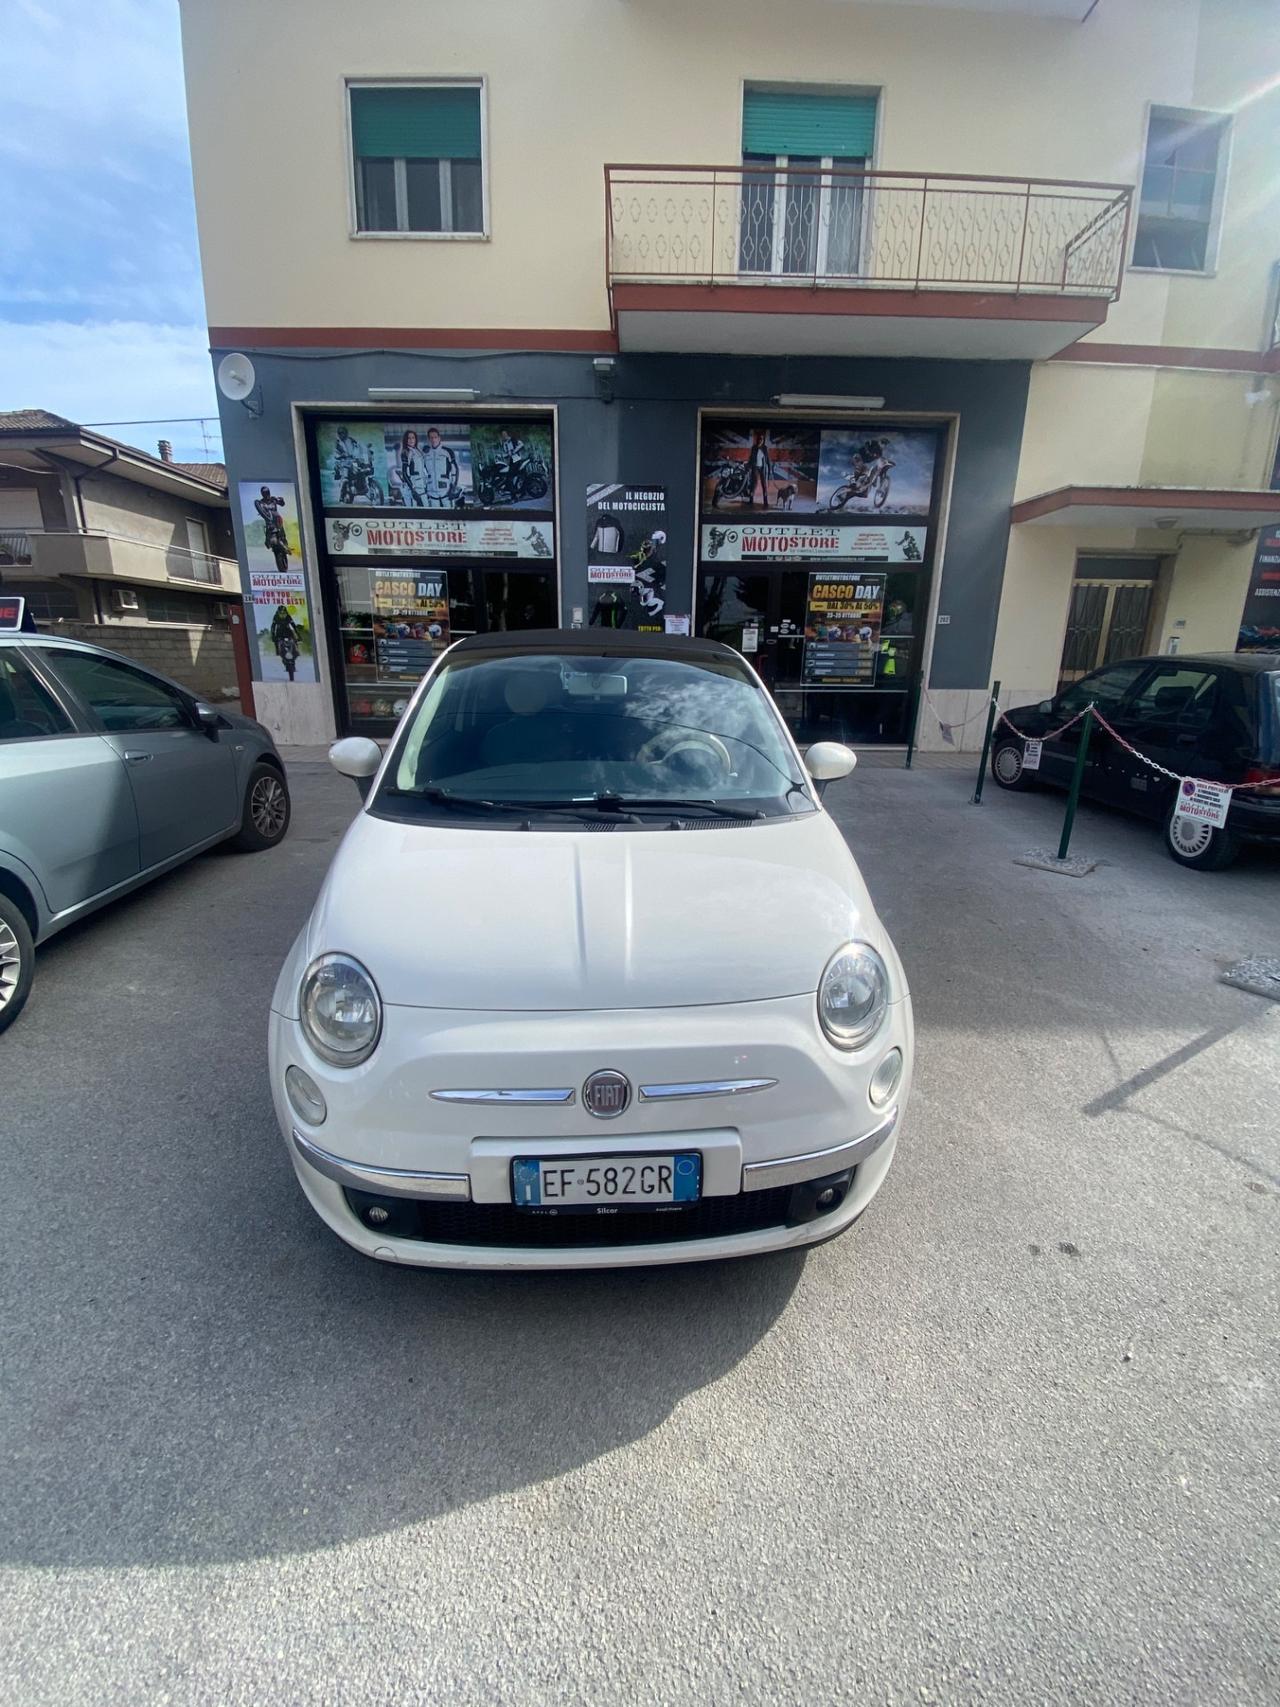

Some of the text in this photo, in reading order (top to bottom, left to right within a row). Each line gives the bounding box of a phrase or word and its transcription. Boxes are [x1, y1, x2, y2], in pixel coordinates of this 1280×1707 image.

[625, 492, 664, 501] IL NEGOZIO
[598, 501, 665, 511] DEL MOTOCICLISTA
[365, 521, 467, 531] OUTLET
[742, 527, 840, 536] OUTLET
[367, 529, 468, 546] MOTOSTORE
[742, 536, 839, 552] MOTOSTORE
[591, 571, 632, 579] MOTOSTORE
[252, 579, 303, 587] MOTOSTORE
[375, 580, 443, 597] CASCO DAY
[812, 584, 881, 599] CASCO DAY
[594, 1084, 621, 1106] FIAT
